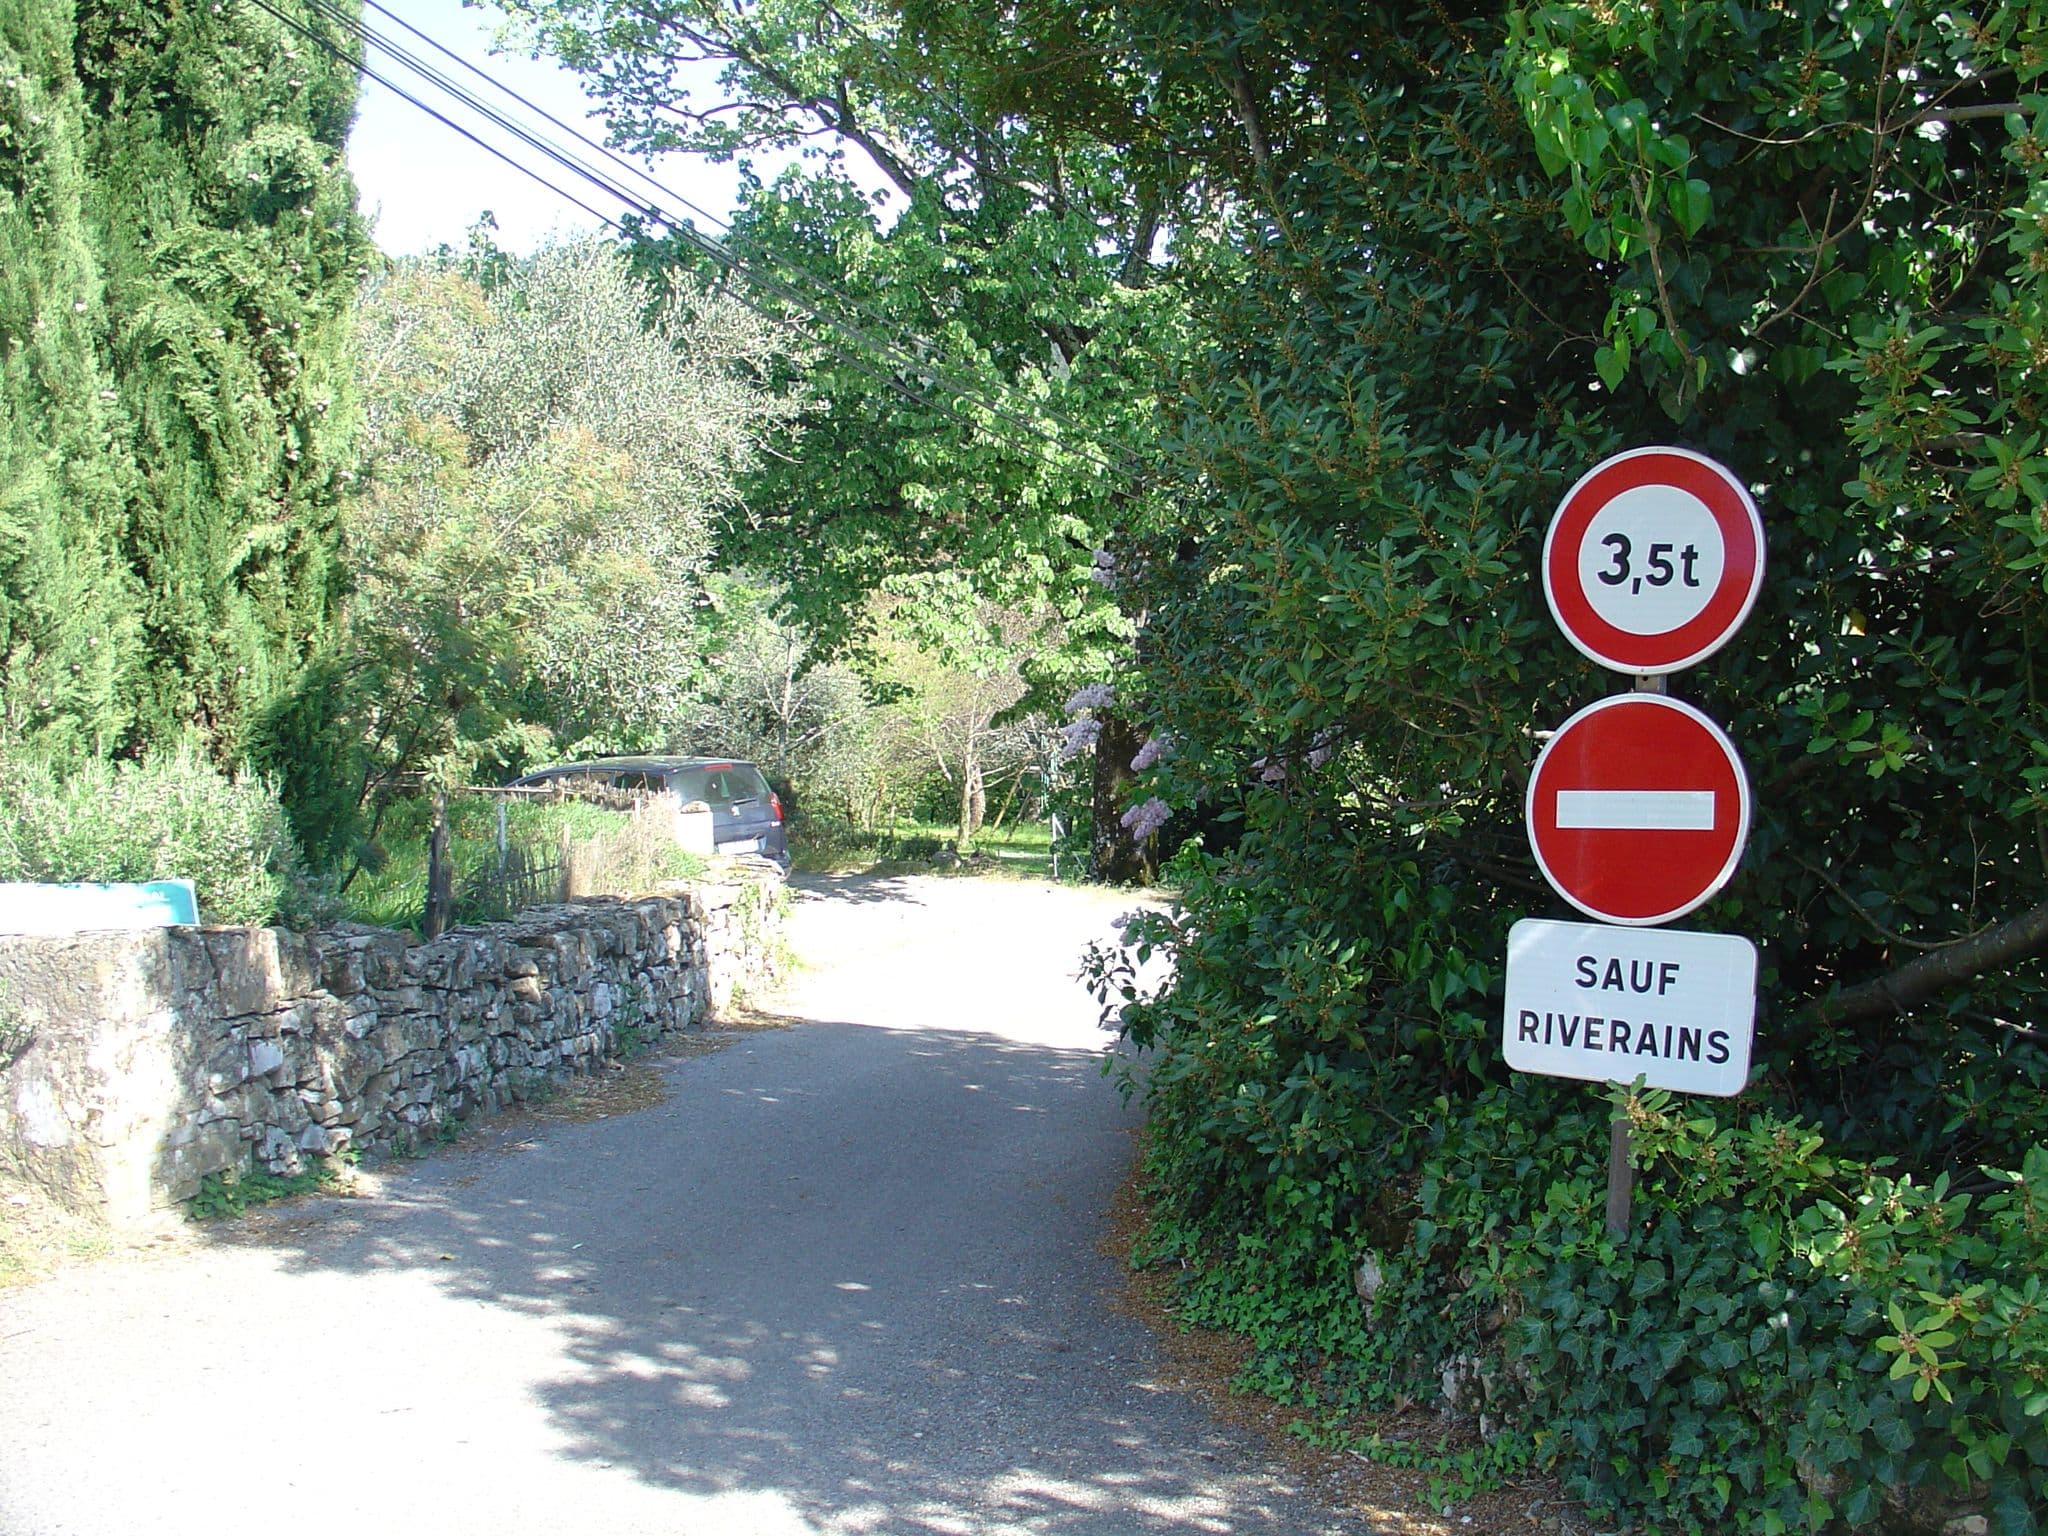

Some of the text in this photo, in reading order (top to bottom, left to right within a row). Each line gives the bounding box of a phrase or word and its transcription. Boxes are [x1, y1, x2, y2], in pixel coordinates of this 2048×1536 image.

[1597, 532, 1700, 595] 3,5t
[1575, 955, 1680, 996] SAUF
[1518, 1009, 1730, 1065] RIVERAINS
